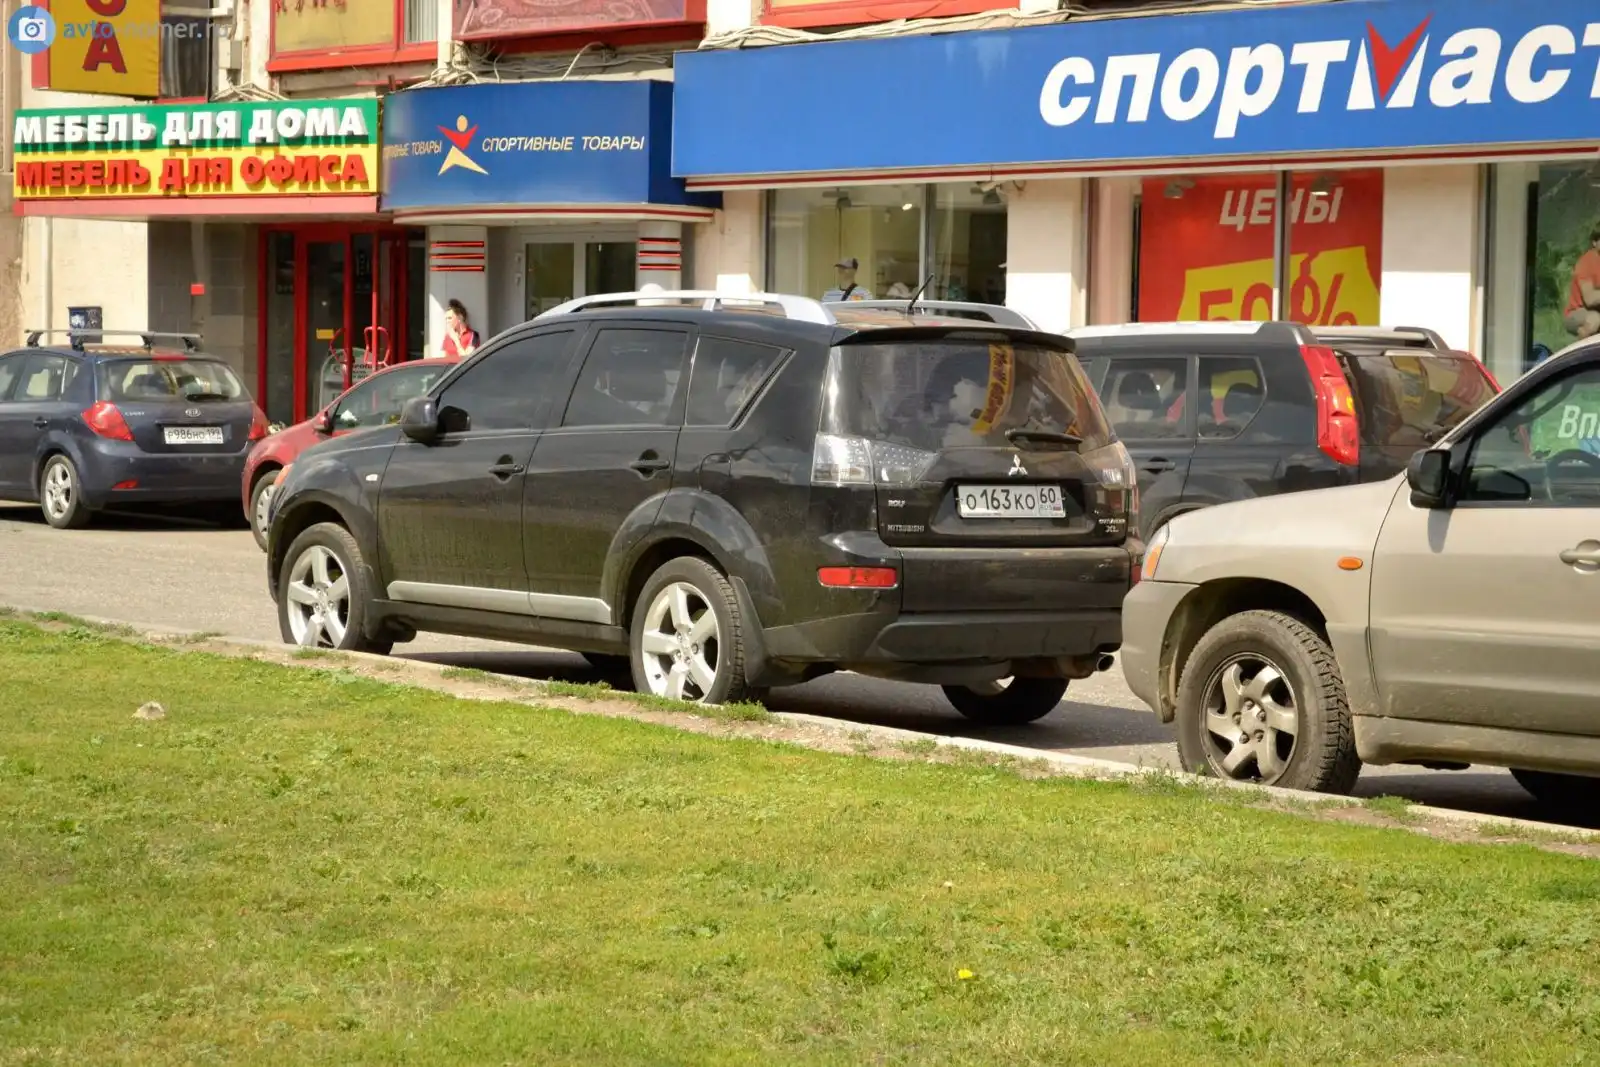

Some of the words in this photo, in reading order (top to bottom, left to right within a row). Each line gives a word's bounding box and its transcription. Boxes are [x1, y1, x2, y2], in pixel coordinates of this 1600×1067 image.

[14, 112, 155, 145] МЕБЕЛЬ
[162, 110, 240, 145] ДЛЯ
[249, 107, 367, 143] ДОМА
[481, 136, 573, 153] СПОРТИВНЫЕ
[581, 135, 644, 151] ТОВАРЫ
[15, 158, 150, 188] МЕБЕЛЬ
[159, 156, 233, 191] ДЛЯ
[240, 154, 368, 184] ОФИСА
[1557, 404, 1600, 439] Вп
[1040, 487, 1056, 504] 60
